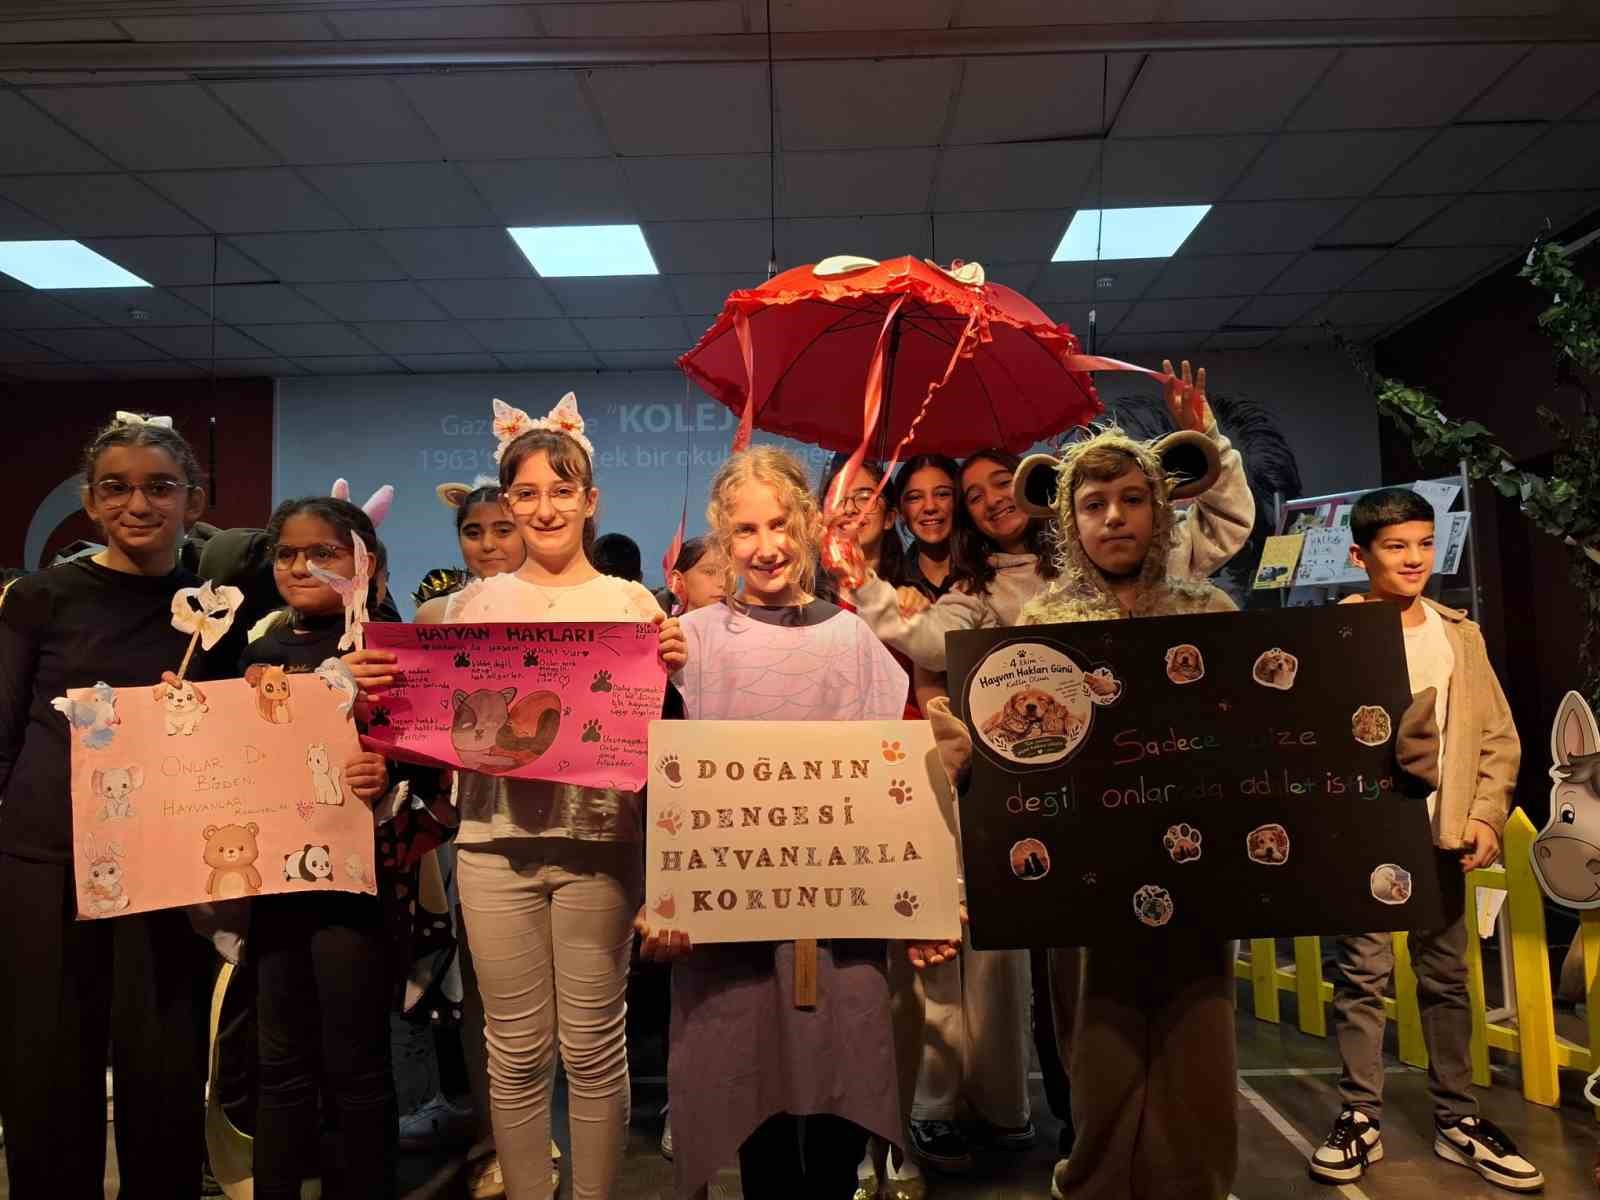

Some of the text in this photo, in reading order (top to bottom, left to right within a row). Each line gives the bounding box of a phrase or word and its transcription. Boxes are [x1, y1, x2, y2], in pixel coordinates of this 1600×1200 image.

[637, 444, 670, 466] bir
[416, 626, 595, 642] HAYVAN HAKLARI
[1010, 658, 1017, 667] 4
[979, 671, 1015, 688] Hayvan
[1050, 664, 1073, 673] Günü
[1112, 727, 1219, 766] Sadece
[697, 757, 870, 781] DOĞANIN
[1006, 776, 1077, 816] değil
[1102, 775, 1178, 808] onlar
[691, 796, 855, 830] DENGESİ
[660, 841, 923, 871] HAYVANLARLA
[692, 886, 869, 912] KORUNUR
